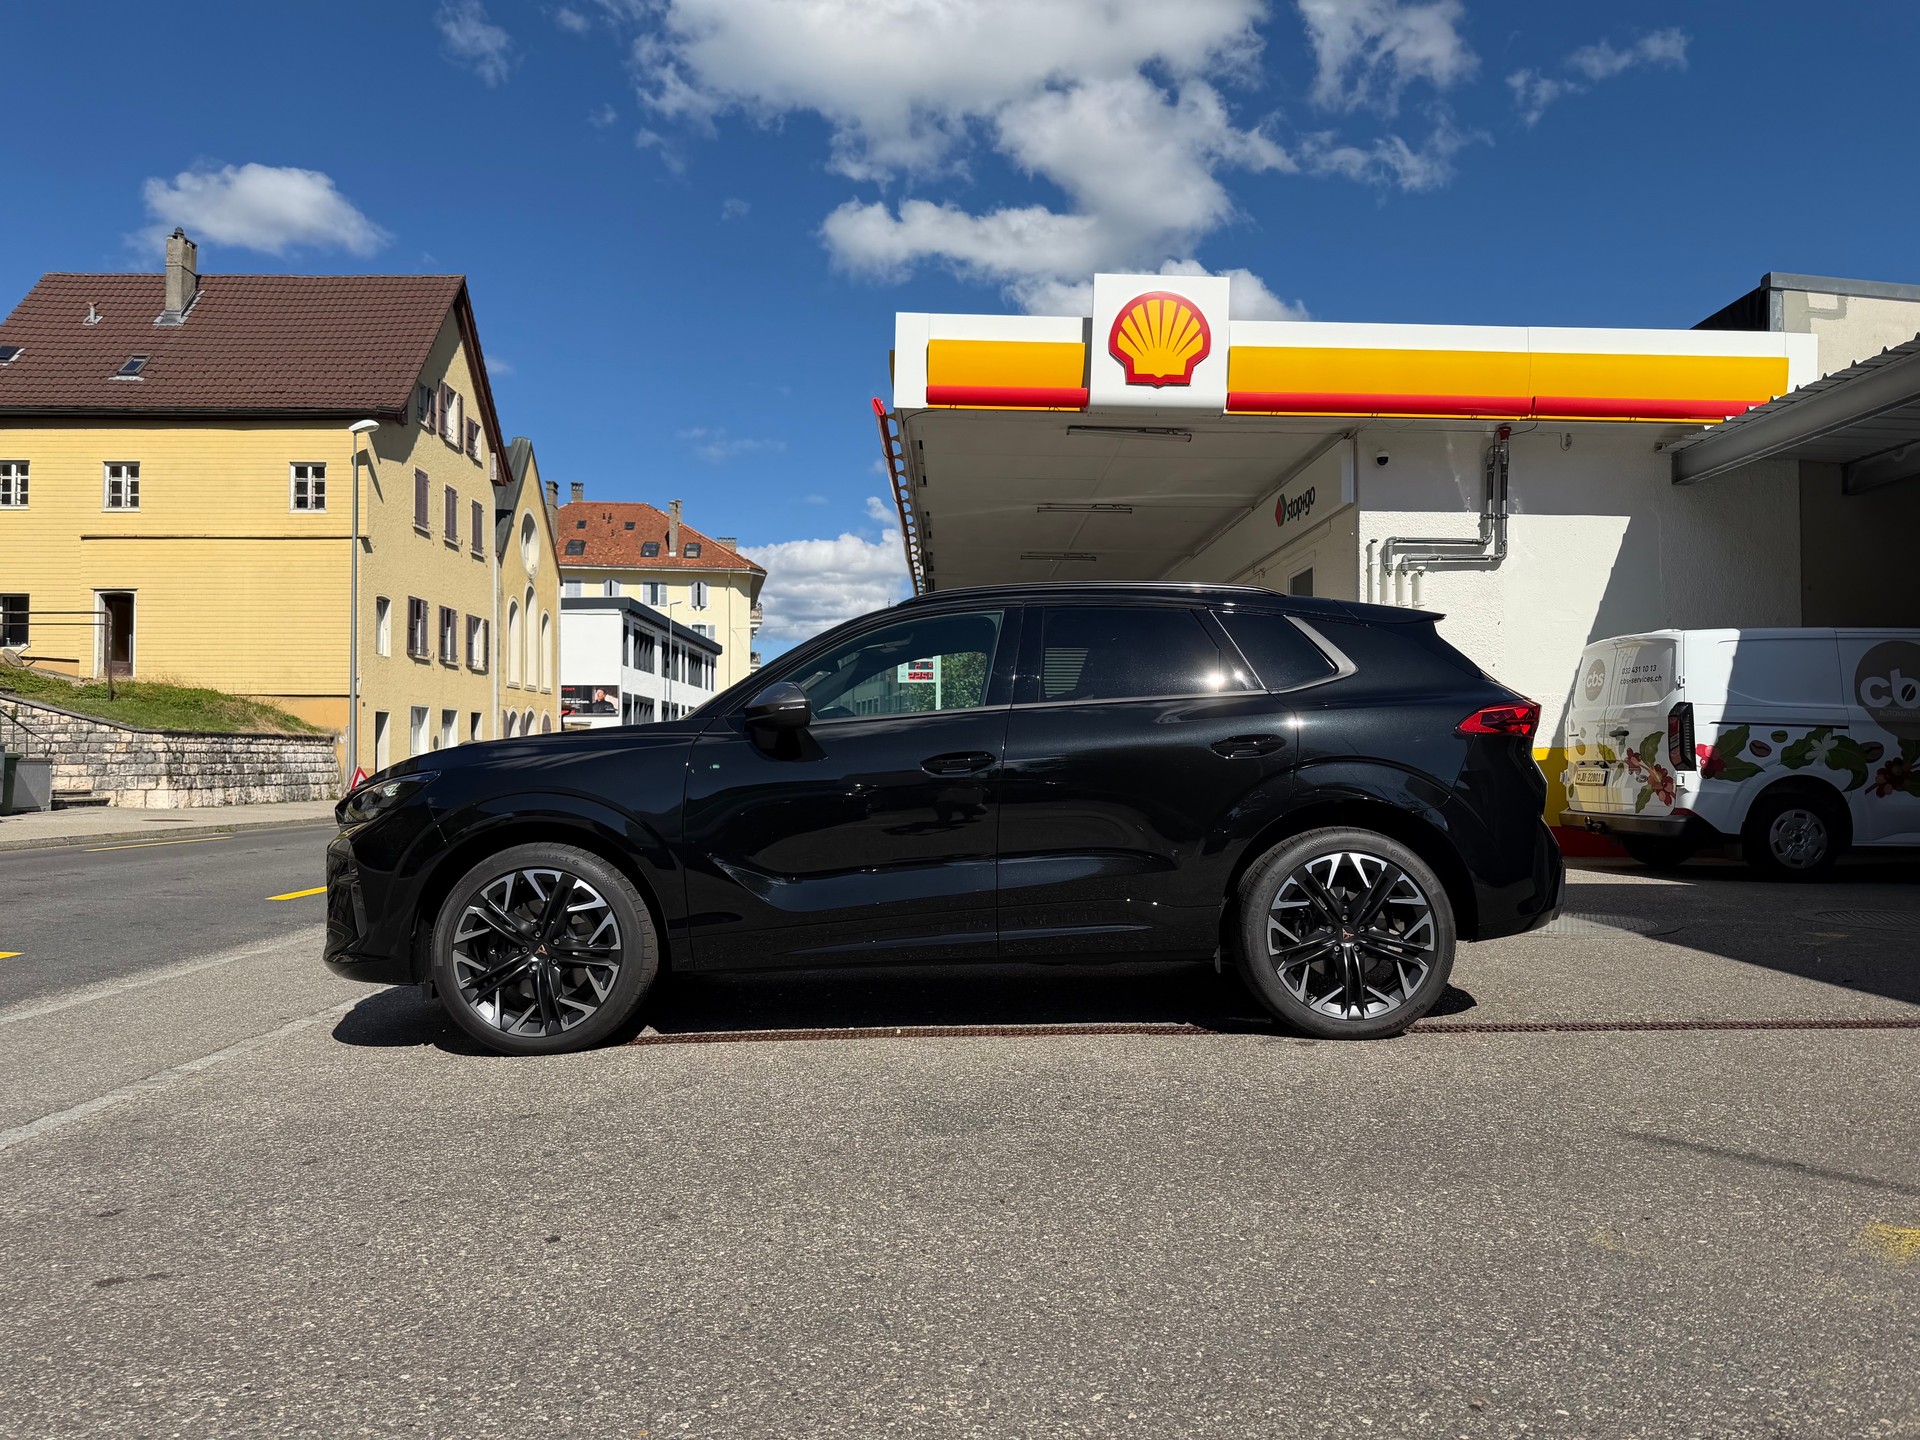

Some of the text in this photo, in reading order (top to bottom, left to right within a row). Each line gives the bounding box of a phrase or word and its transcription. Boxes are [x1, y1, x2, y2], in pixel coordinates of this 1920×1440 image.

[1650, 664, 1657, 672] 13
[1586, 670, 1605, 688] cbs
[1620, 674, 1663, 685] cbs-services.ch
[1860, 668, 1920, 709] cb
